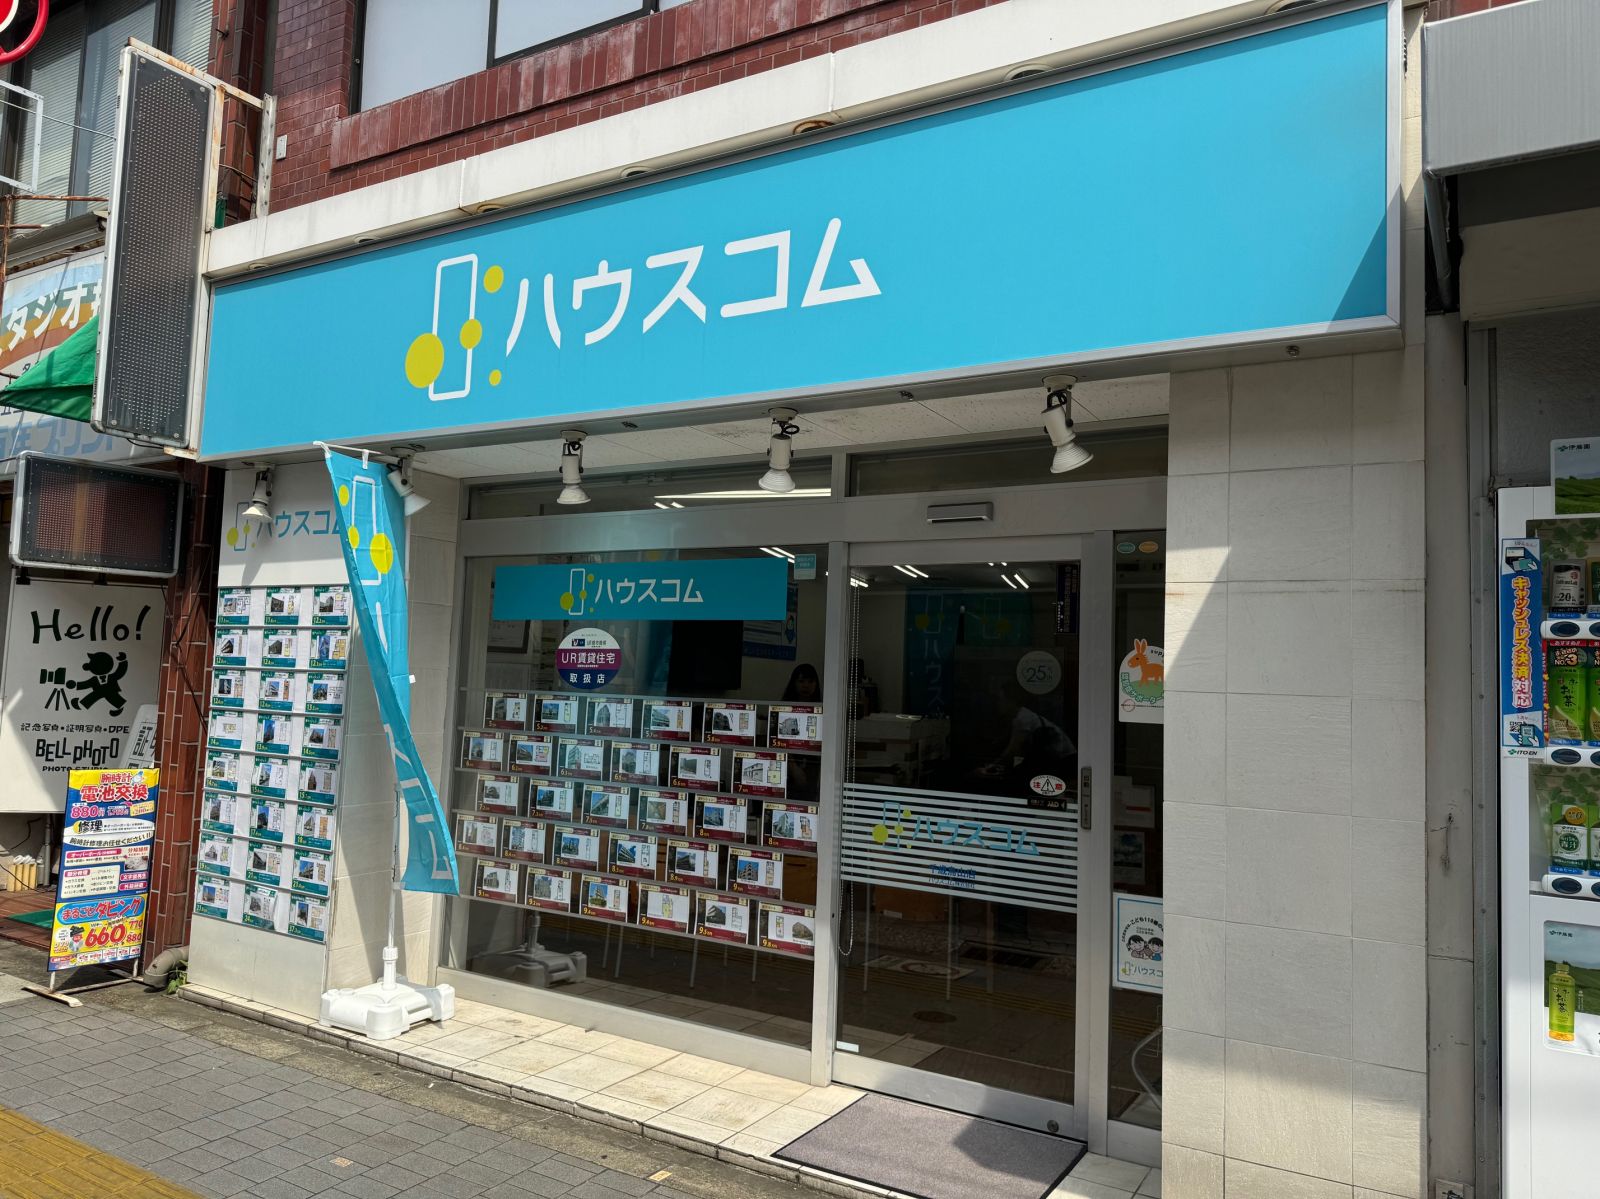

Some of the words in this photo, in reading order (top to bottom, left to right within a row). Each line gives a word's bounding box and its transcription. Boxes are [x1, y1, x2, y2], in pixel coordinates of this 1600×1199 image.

[506, 217, 882, 357] ハウスコム
[0, 279, 103, 357] タジオ
[594, 578, 704, 604] ハウスコム
[31, 604, 151, 644] Hello!
[1512, 576, 1533, 709] キャッシュレス決済対応
[561, 652, 615, 664] UR賃貸住宅
[35, 737, 72, 763] BELL
[72, 737, 120, 767] PHOTO
[100, 772, 132, 784] 腕時計
[80, 784, 148, 802] 電池交換
[912, 815, 1040, 856] ハウスコム
[62, 898, 142, 921] まるごとダビング
[84, 923, 126, 948] 660
